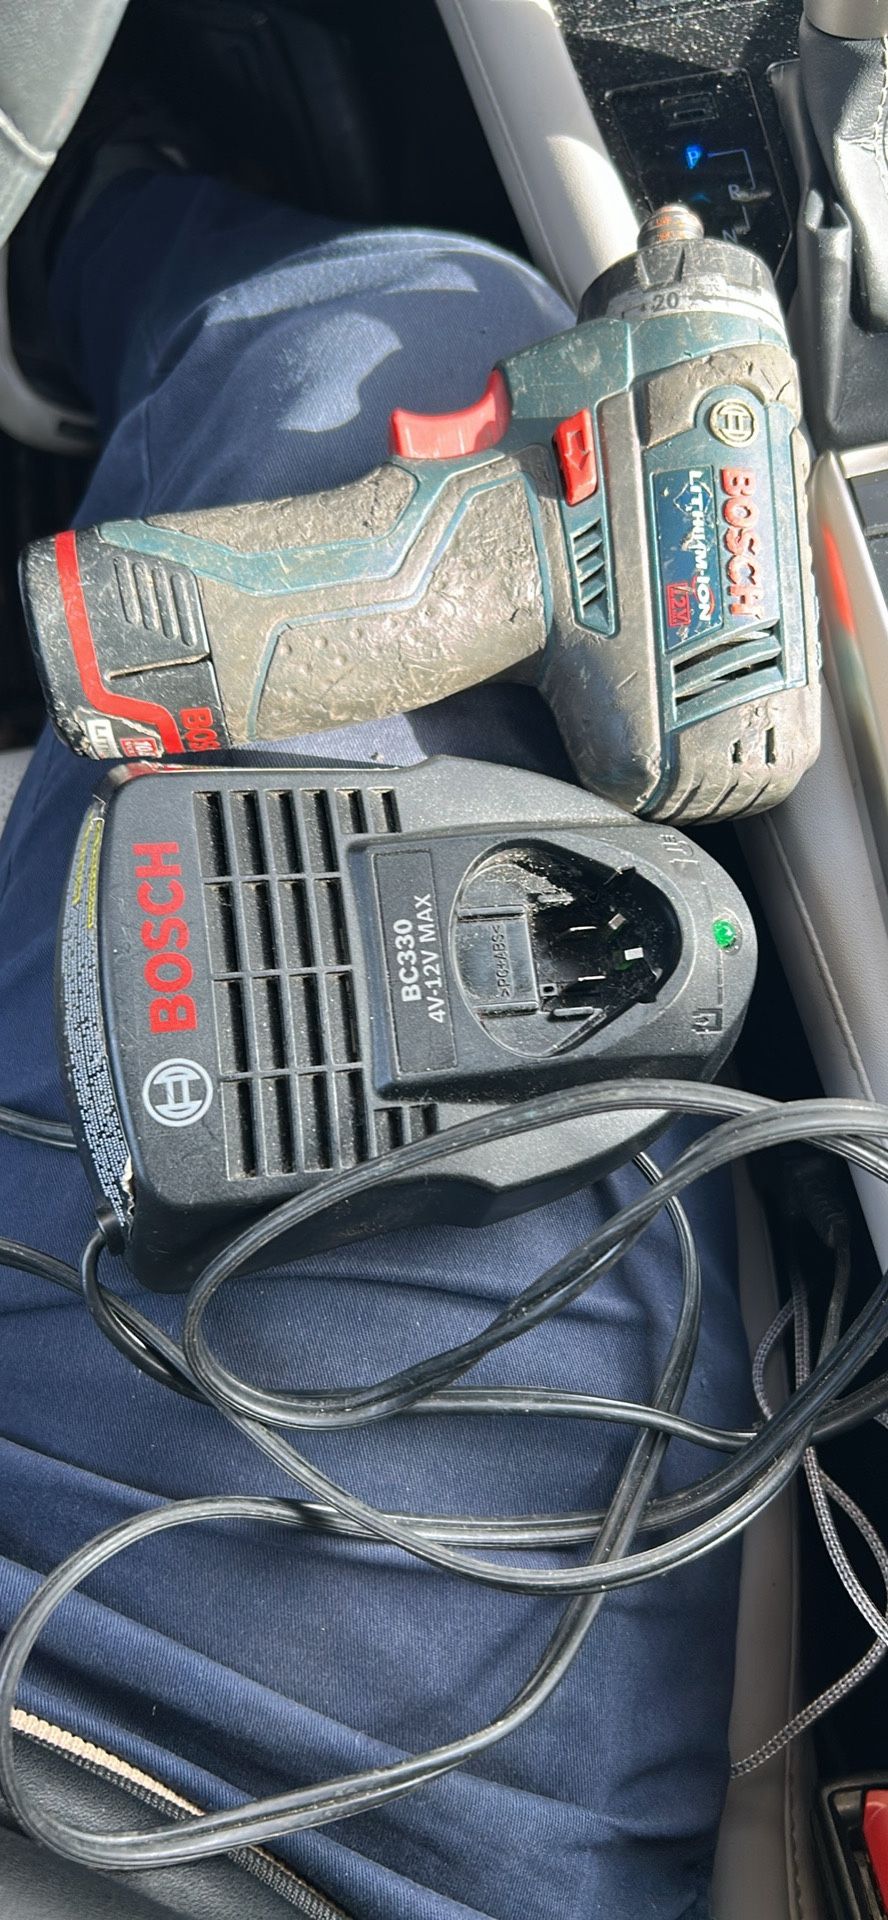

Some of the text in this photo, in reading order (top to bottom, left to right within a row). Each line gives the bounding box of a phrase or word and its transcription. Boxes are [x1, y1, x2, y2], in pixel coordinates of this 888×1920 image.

[686, 148, 700, 169] P
[728, 184, 742, 200] R
[722, 228, 738, 245] N
[652, 291, 679, 312] 20
[722, 467, 764, 618] BOSCH
[132, 841, 197, 1034] BOSCH
[393, 918, 422, 1003] BC330
[413, 893, 446, 1025] 4V-12V MAX
